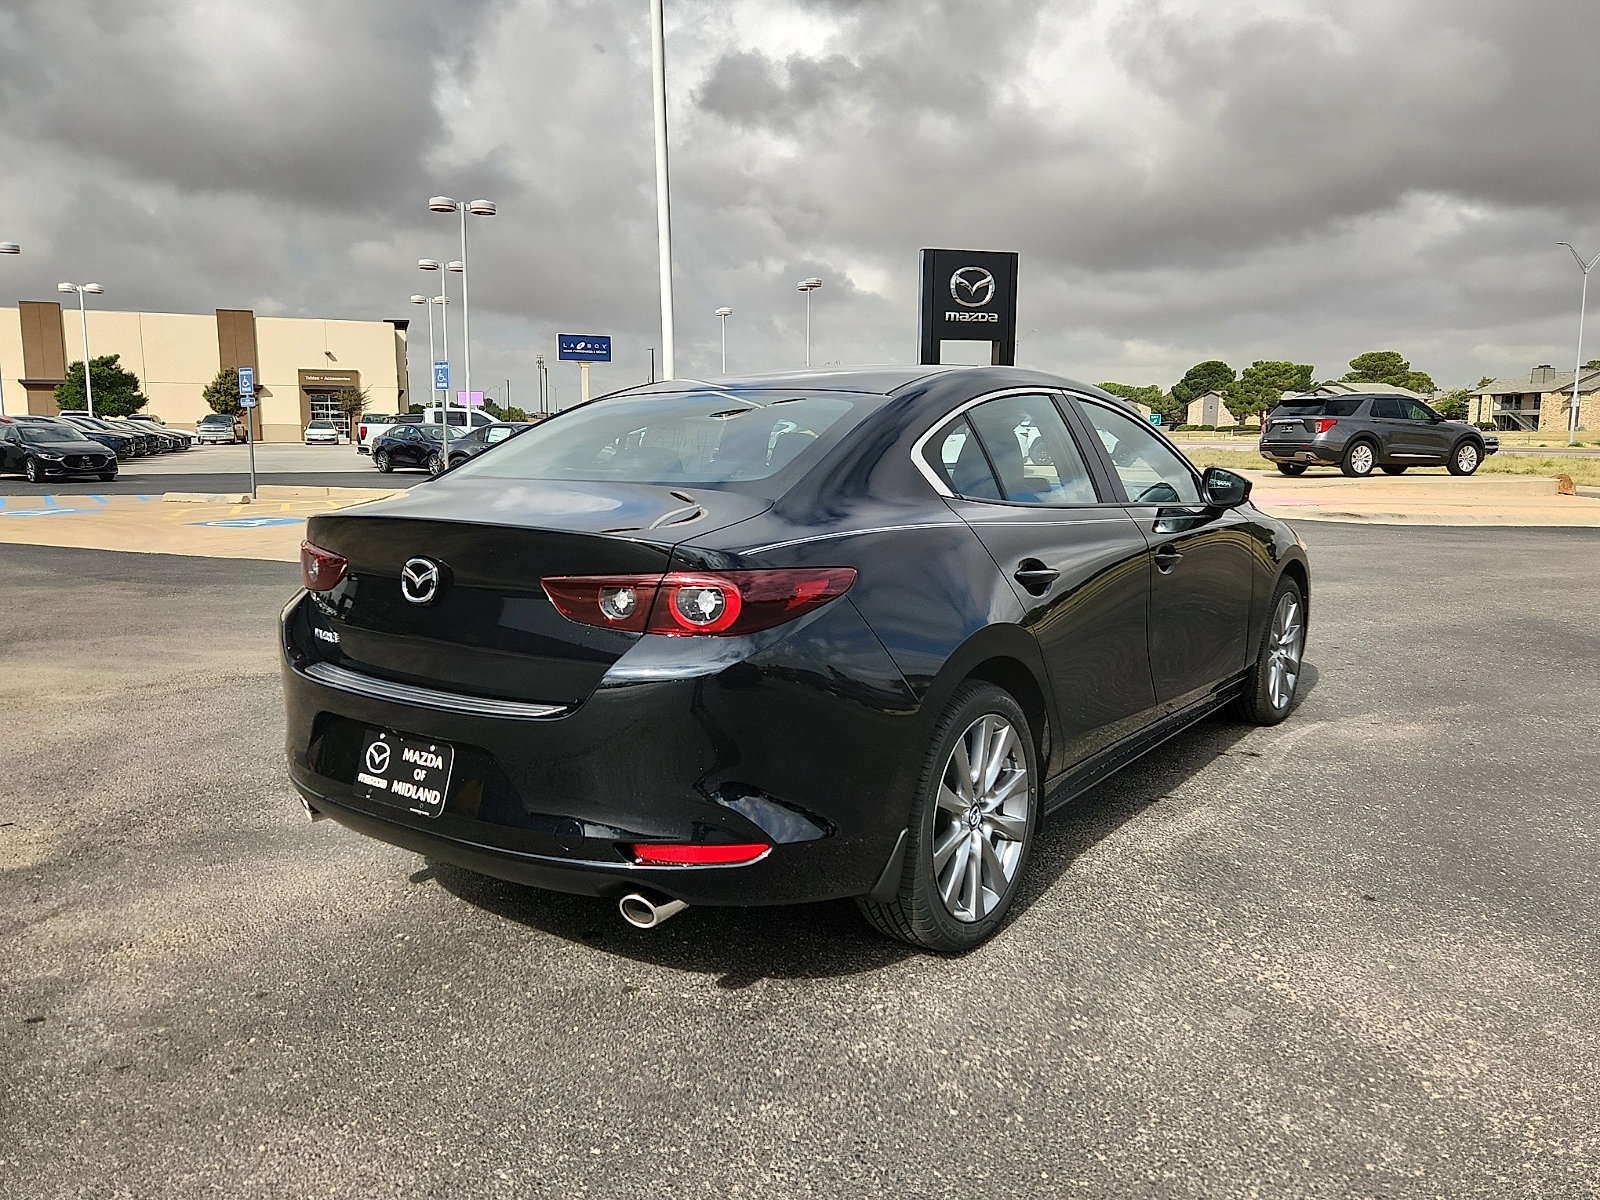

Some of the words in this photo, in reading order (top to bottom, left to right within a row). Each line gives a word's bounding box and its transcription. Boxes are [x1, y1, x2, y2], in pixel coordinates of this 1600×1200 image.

[402, 747, 443, 770] MAZDA
[413, 768, 427, 782] OF
[391, 780, 441, 805] MIDLAND
